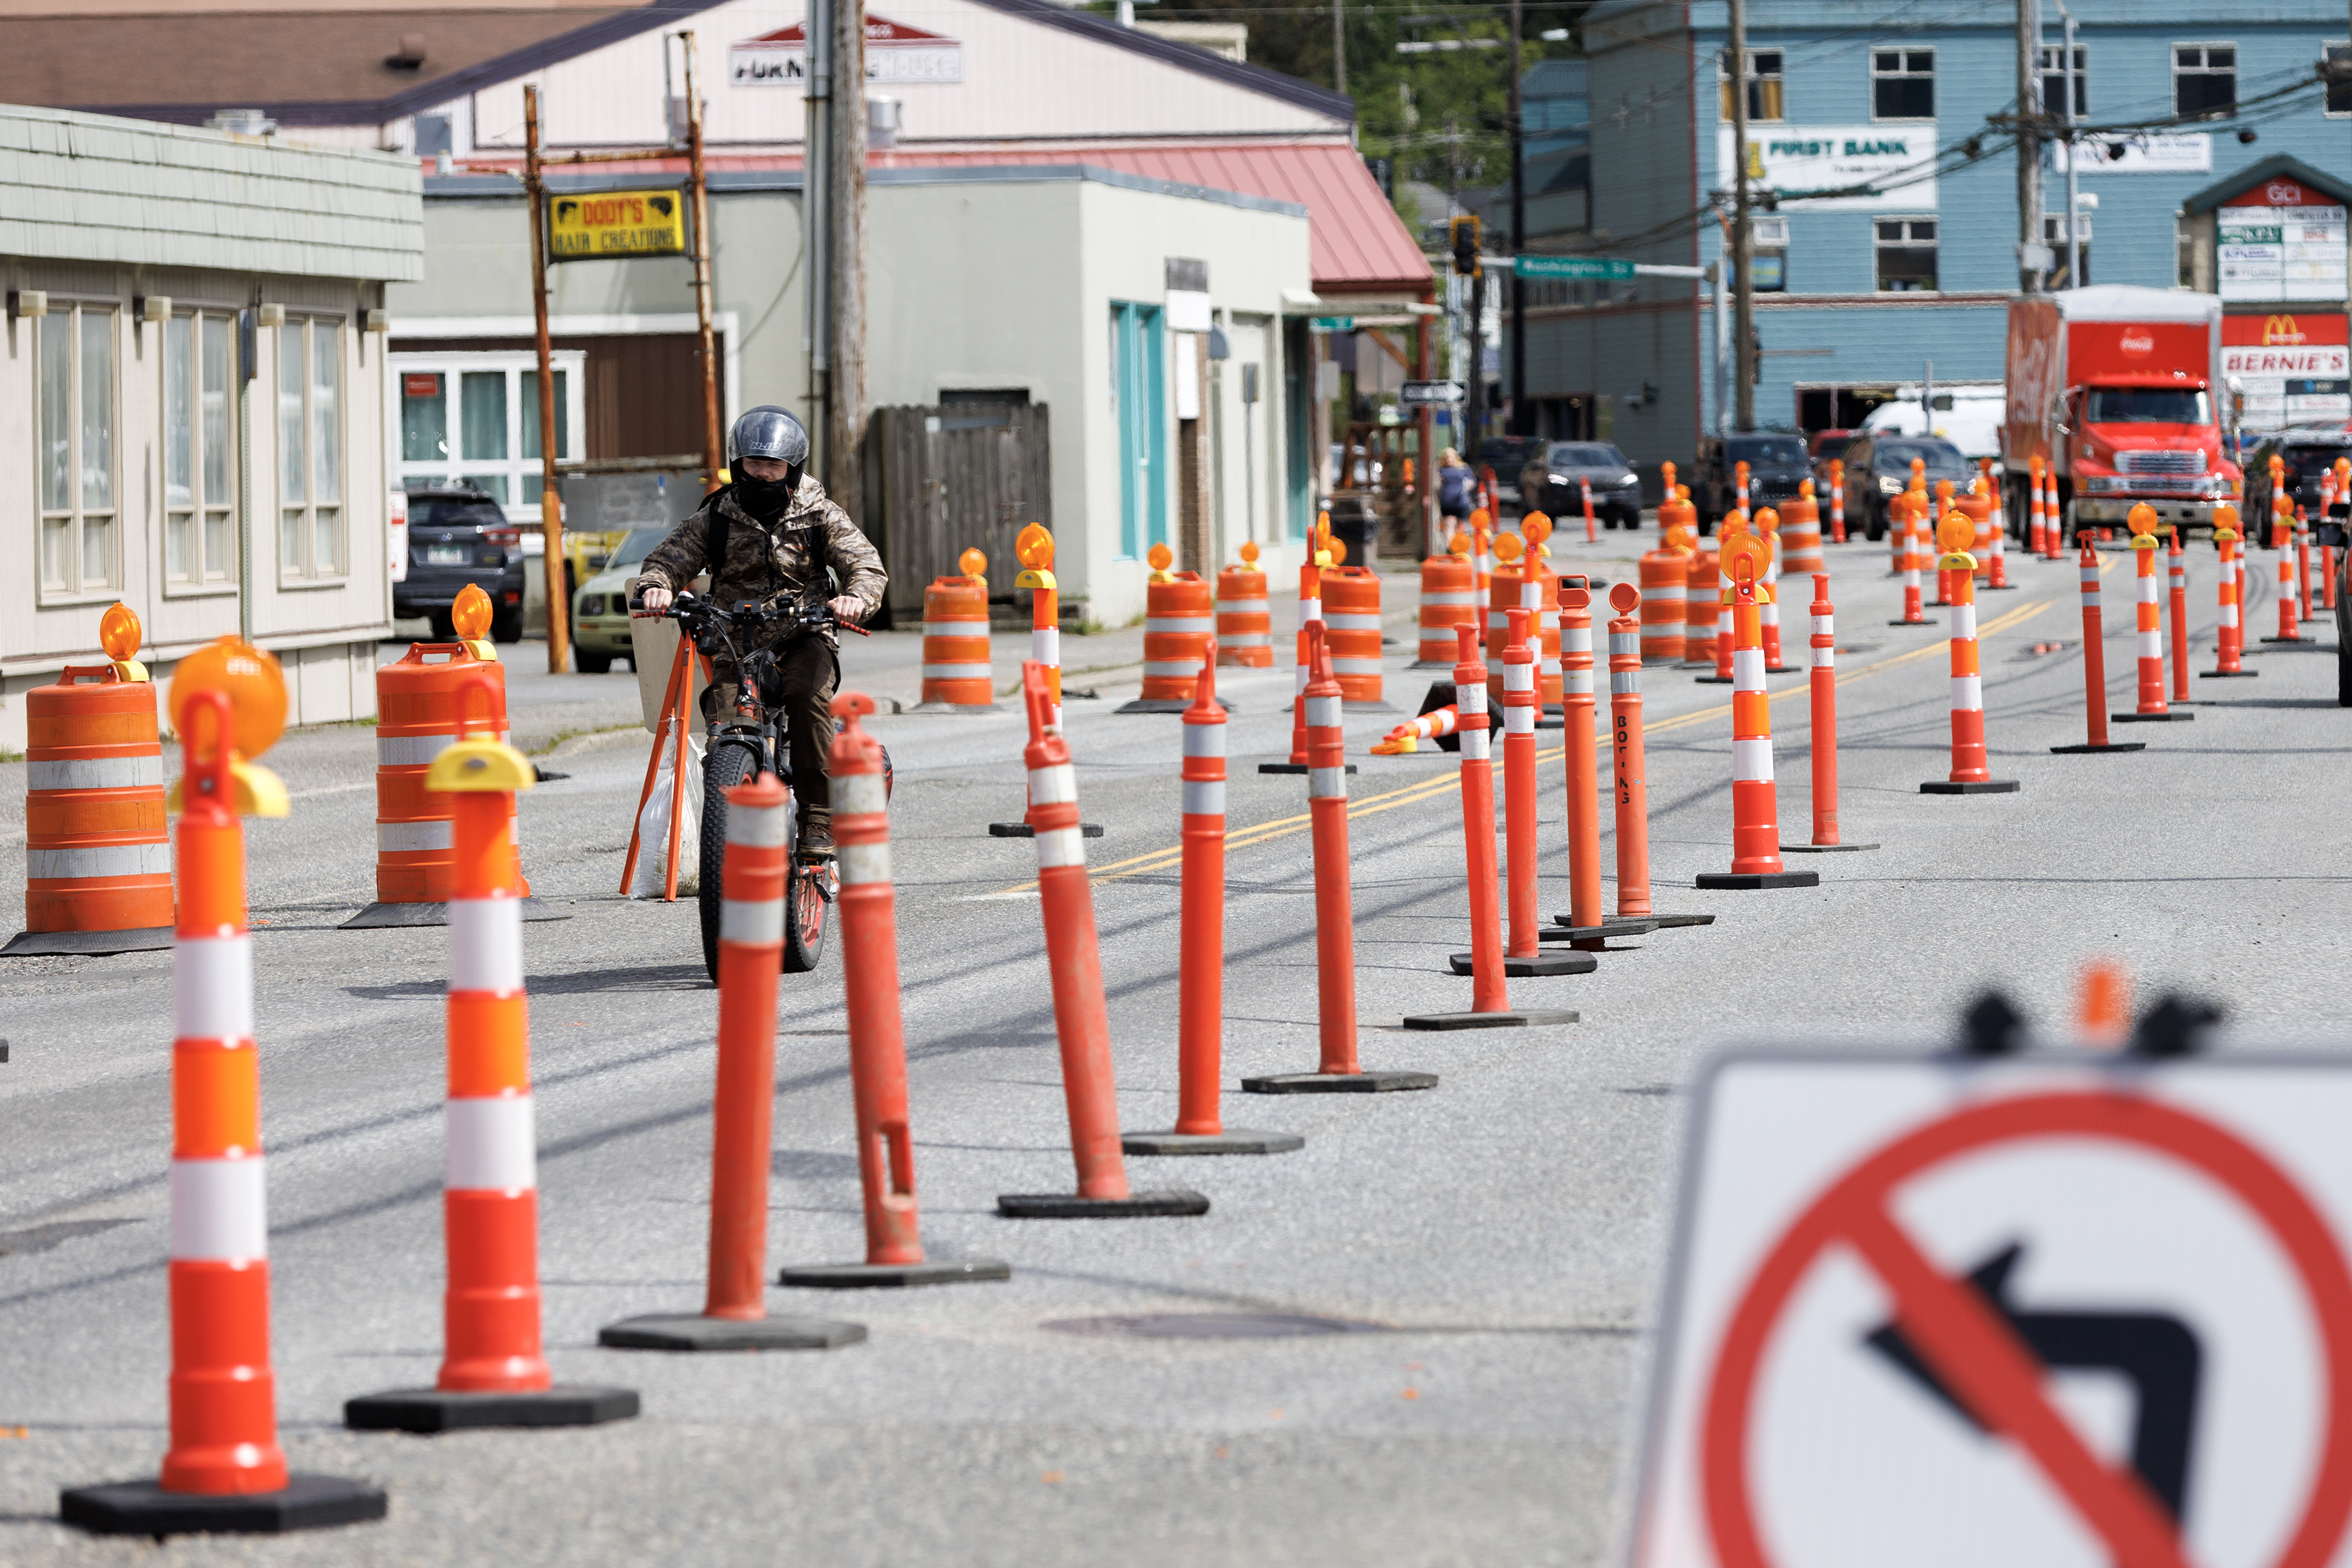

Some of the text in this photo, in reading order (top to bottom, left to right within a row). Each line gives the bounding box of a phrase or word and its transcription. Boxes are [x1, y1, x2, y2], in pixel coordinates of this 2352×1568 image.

[1769, 139, 1908, 155] FIRST BANK
[2266, 184, 2301, 205] GCI
[583, 198, 644, 225] DODY'S
[555, 227, 674, 252] HAIR CREATIONS
[2227, 352, 2345, 373] BERNIE'S
